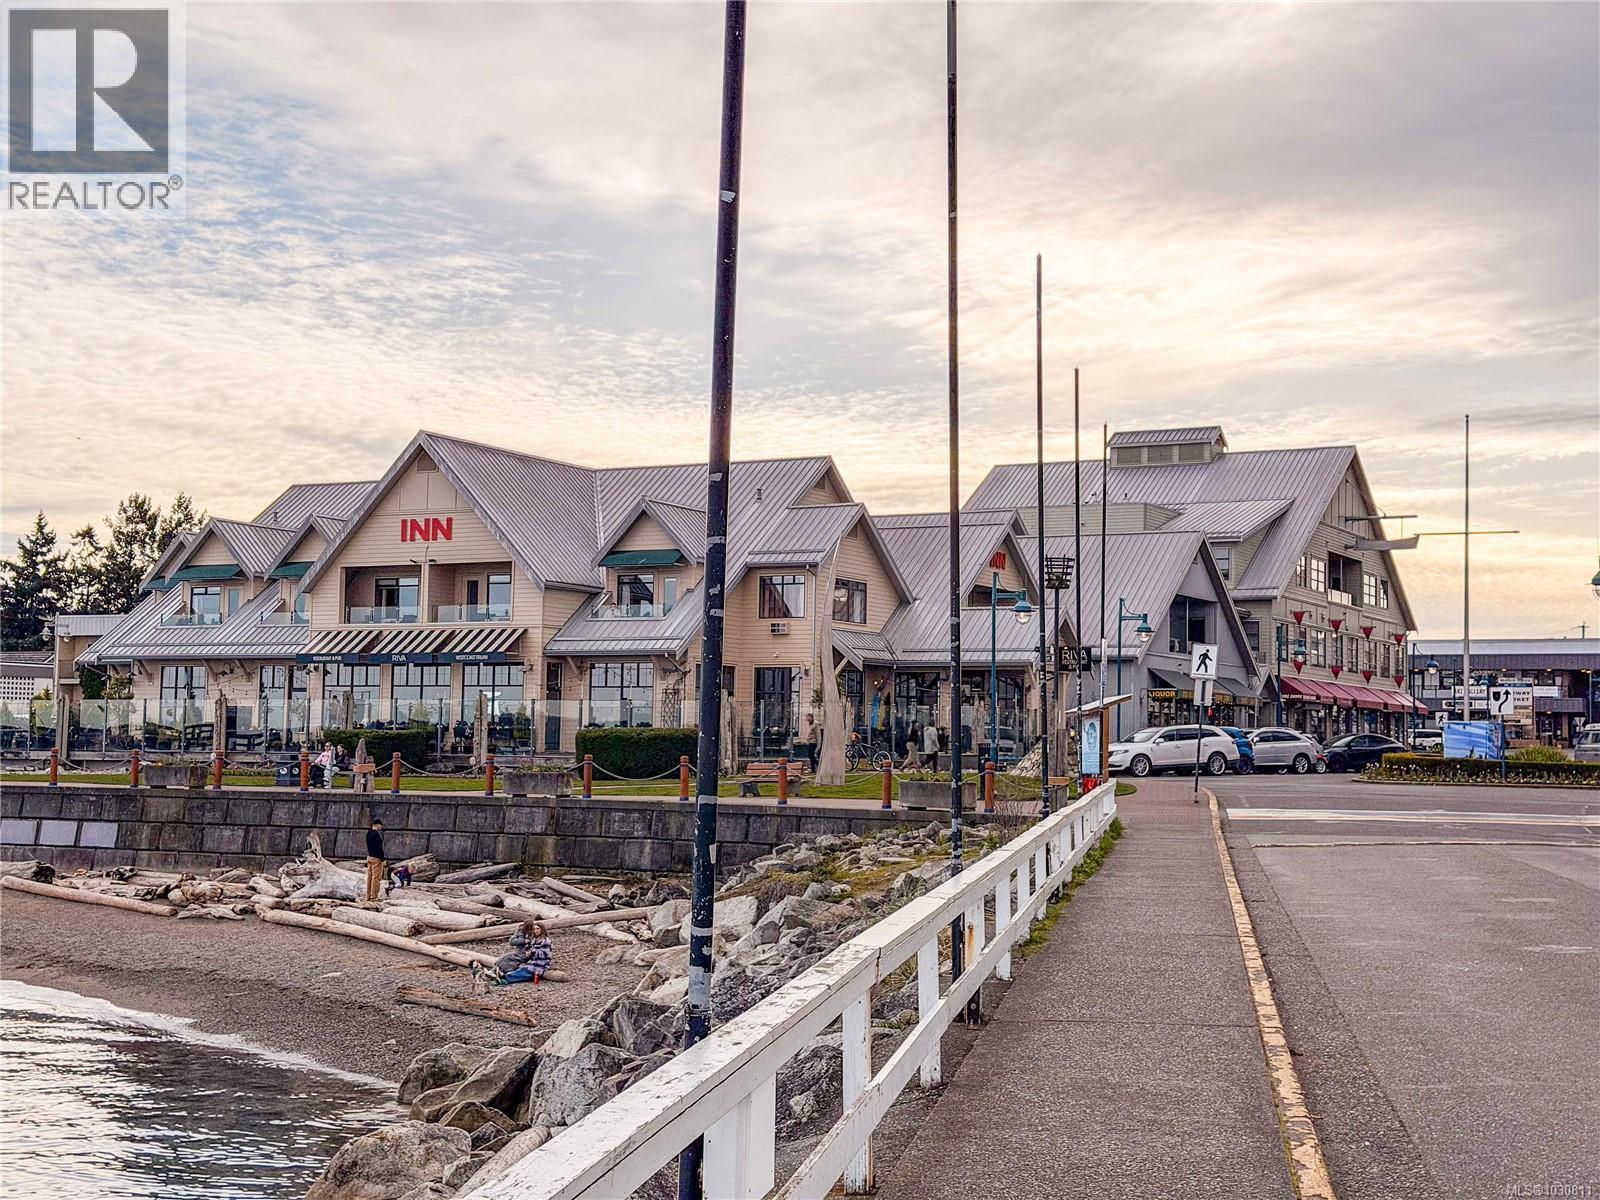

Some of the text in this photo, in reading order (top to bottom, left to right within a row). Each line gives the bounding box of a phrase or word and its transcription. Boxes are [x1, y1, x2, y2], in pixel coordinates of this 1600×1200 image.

[400, 517, 454, 542] INN
[392, 654, 407, 662] RIVA
[1148, 690, 1176, 698] LIQUOR
